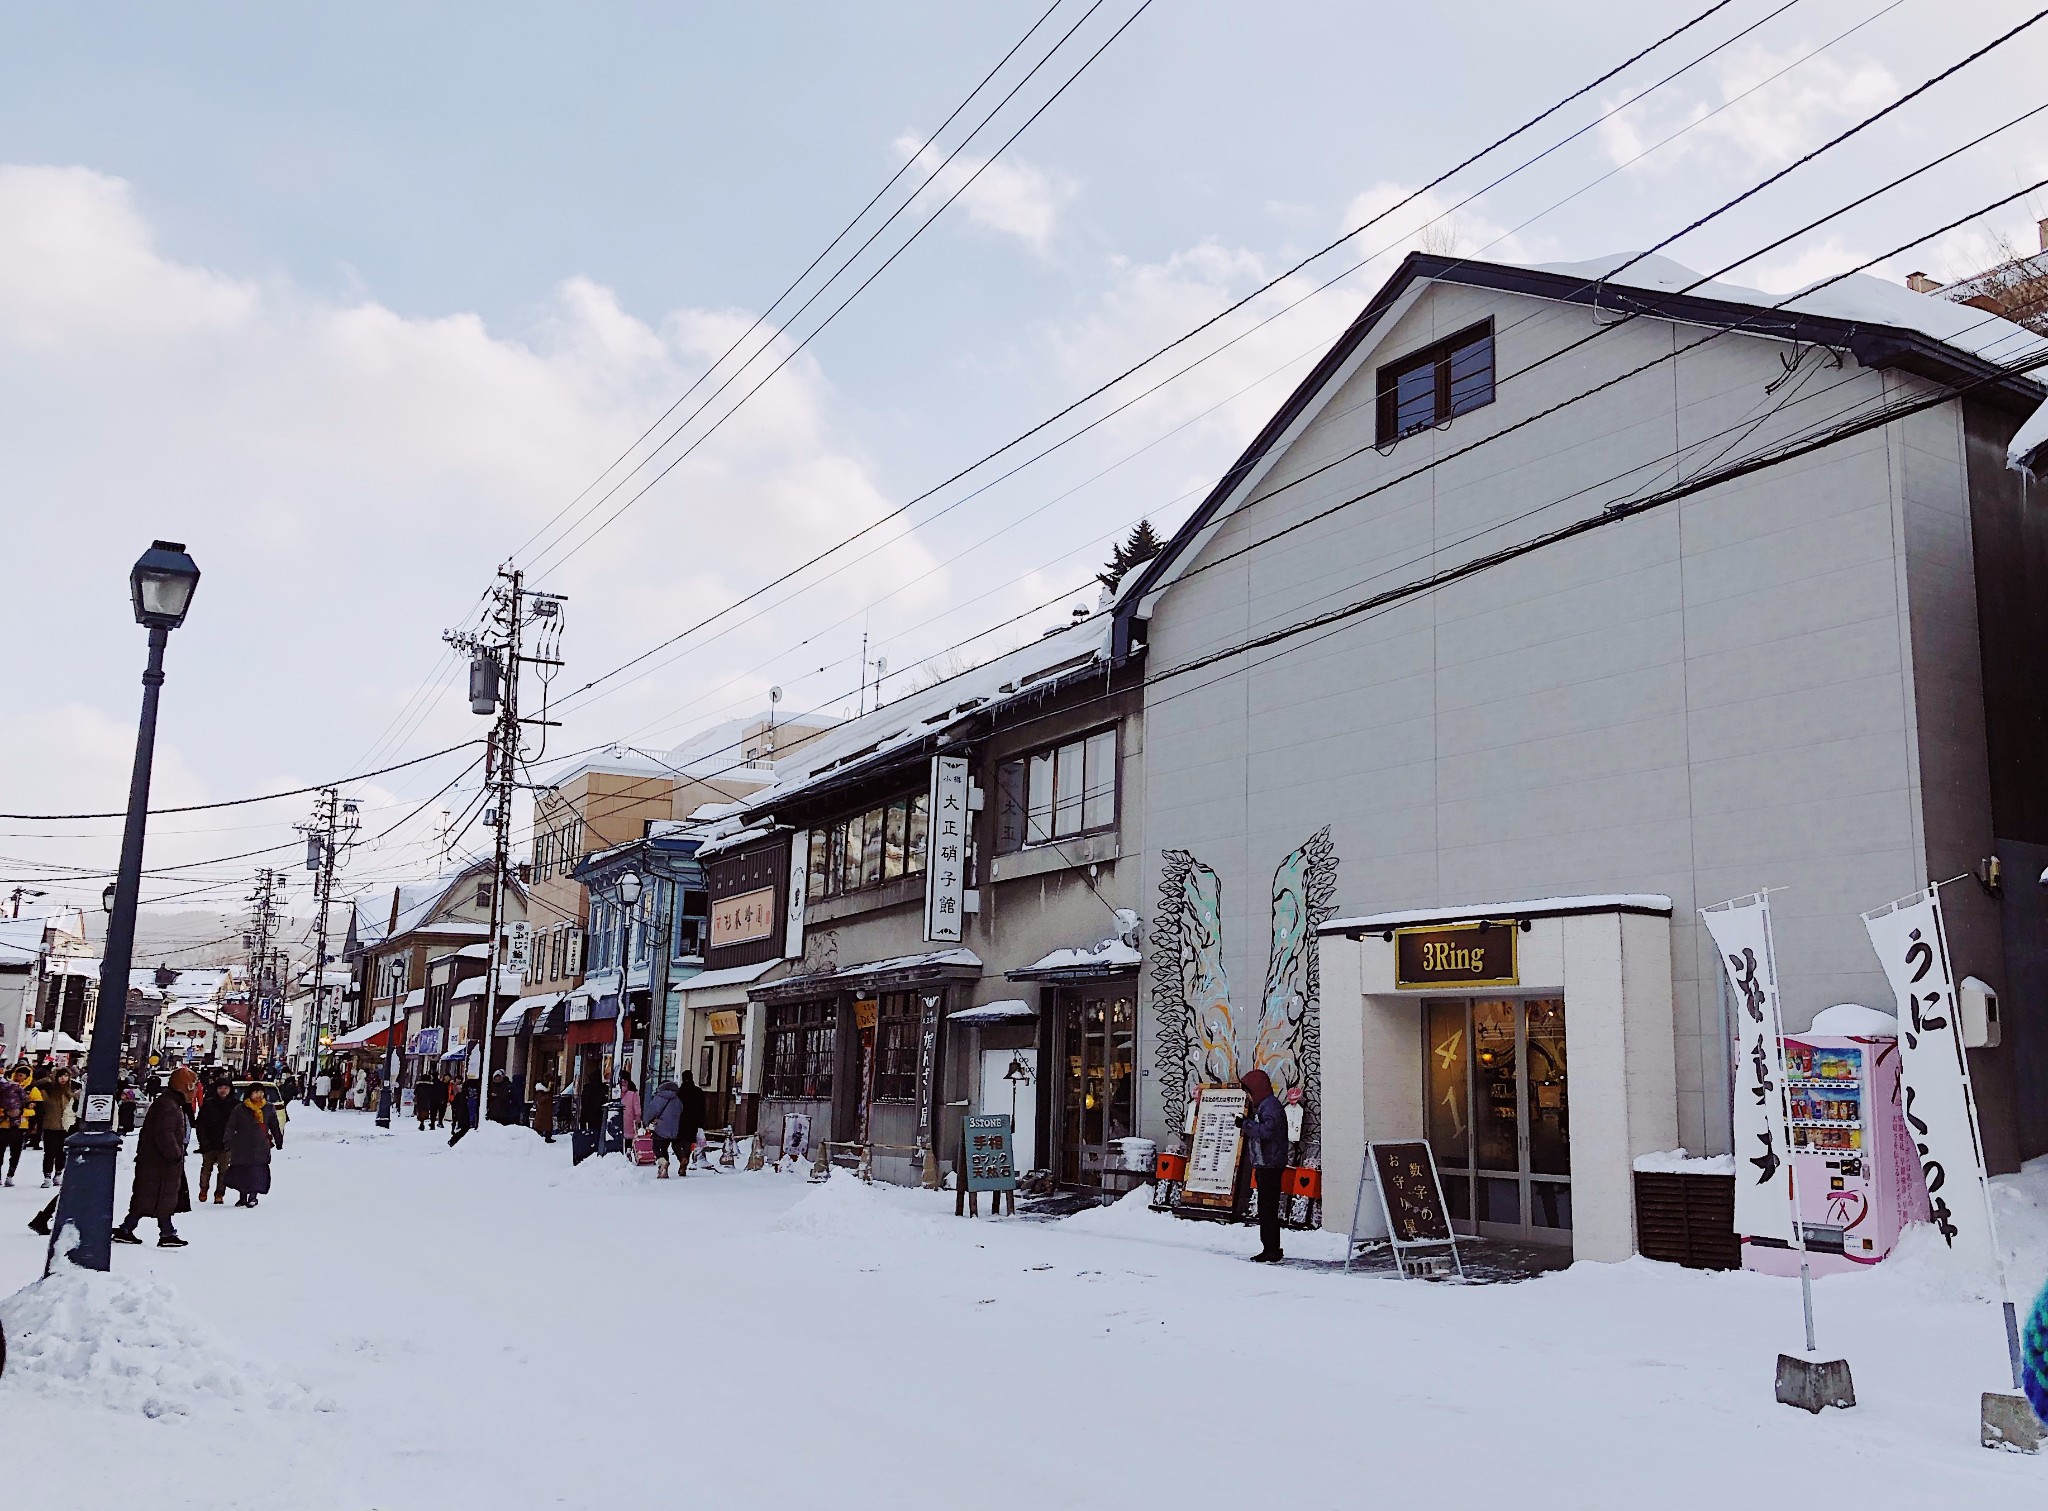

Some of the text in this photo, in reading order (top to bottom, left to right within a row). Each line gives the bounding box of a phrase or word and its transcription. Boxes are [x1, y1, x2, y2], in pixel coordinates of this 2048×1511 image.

[939, 793, 960, 914] 大正硝子館
[1423, 941, 1485, 973] 3Ring
[1434, 1029, 1463, 1070] 4
[969, 1117, 1003, 1128] 3STONE
[973, 1134, 1004, 1150] 手相
[972, 1164, 1011, 1179] 天然石
[1388, 1154, 1419, 1237] お守り屋
[1409, 1162, 1433, 1221] 数字の
